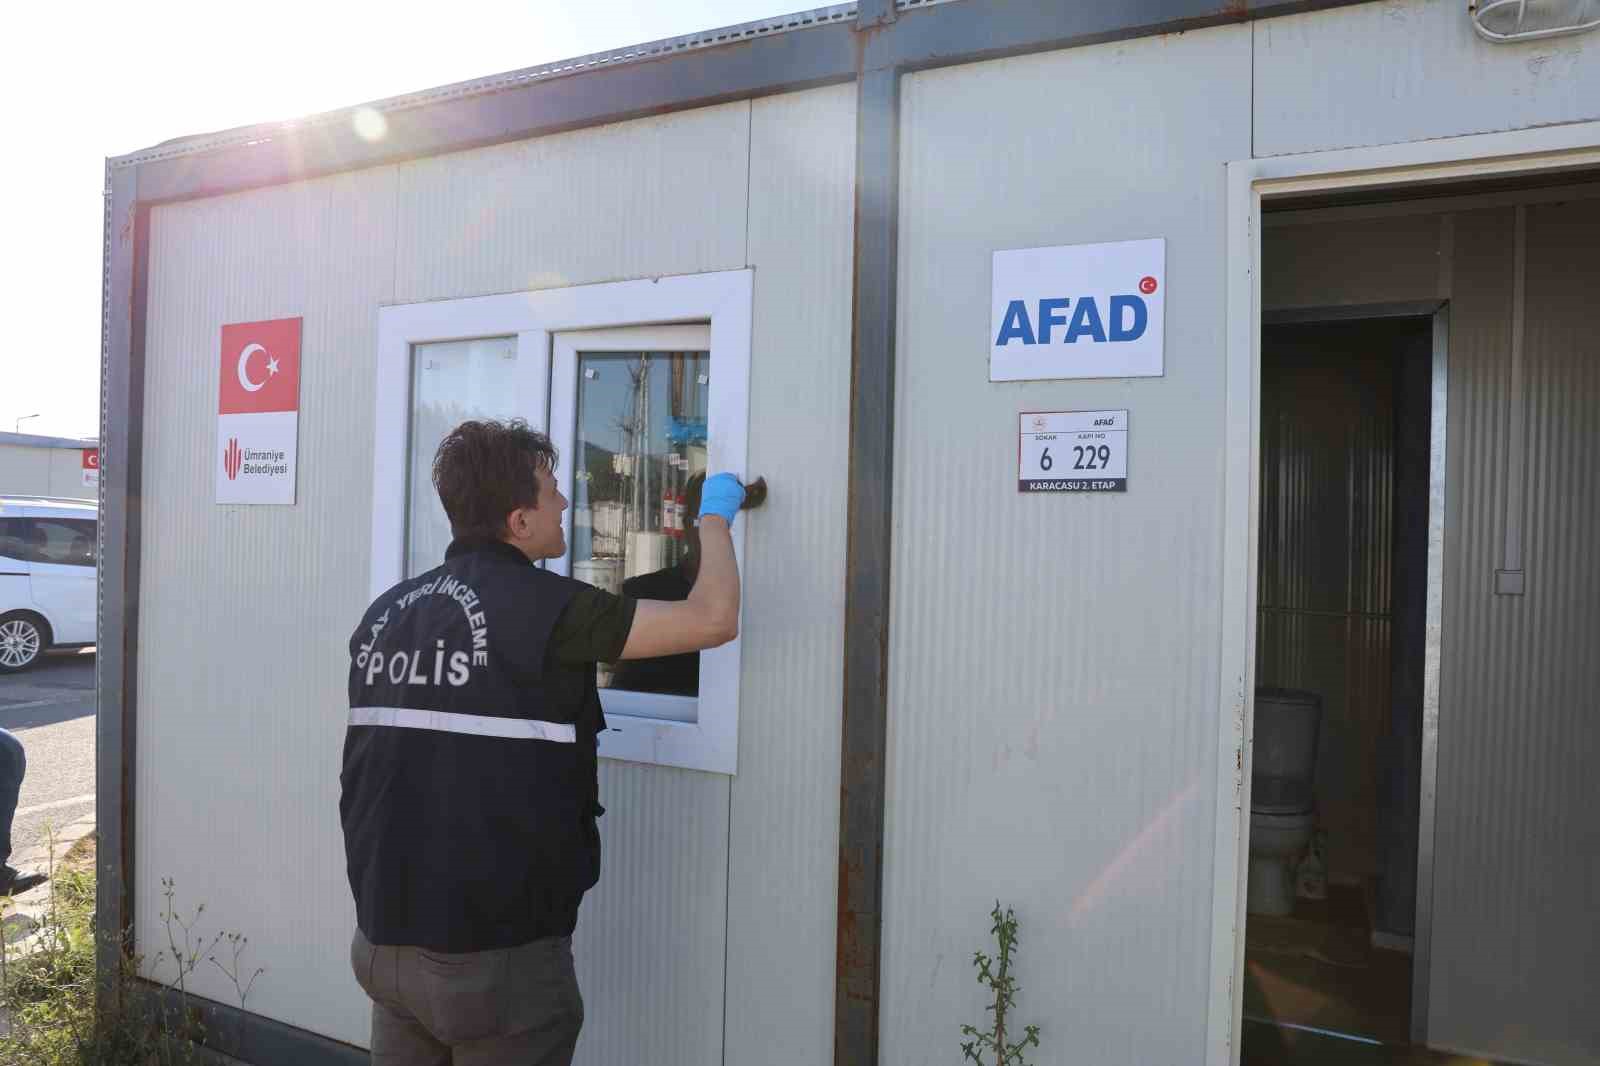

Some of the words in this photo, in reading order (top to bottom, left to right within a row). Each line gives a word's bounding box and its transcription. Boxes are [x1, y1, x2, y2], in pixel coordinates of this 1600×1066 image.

[996, 294, 1148, 346] AFAD
[1093, 418, 1114, 426] AFAD
[244, 448, 285, 462] Ümraniye
[1040, 447, 1053, 471] 6
[1072, 445, 1111, 470] 229
[243, 463, 288, 476] Belediyesi
[1030, 481, 1080, 491] KARACASU
[1082, 481, 1090, 490] 2.
[1092, 481, 1116, 489] ETAP
[356, 608, 390, 669] OLAY
[365, 639, 470, 686] POLİS
